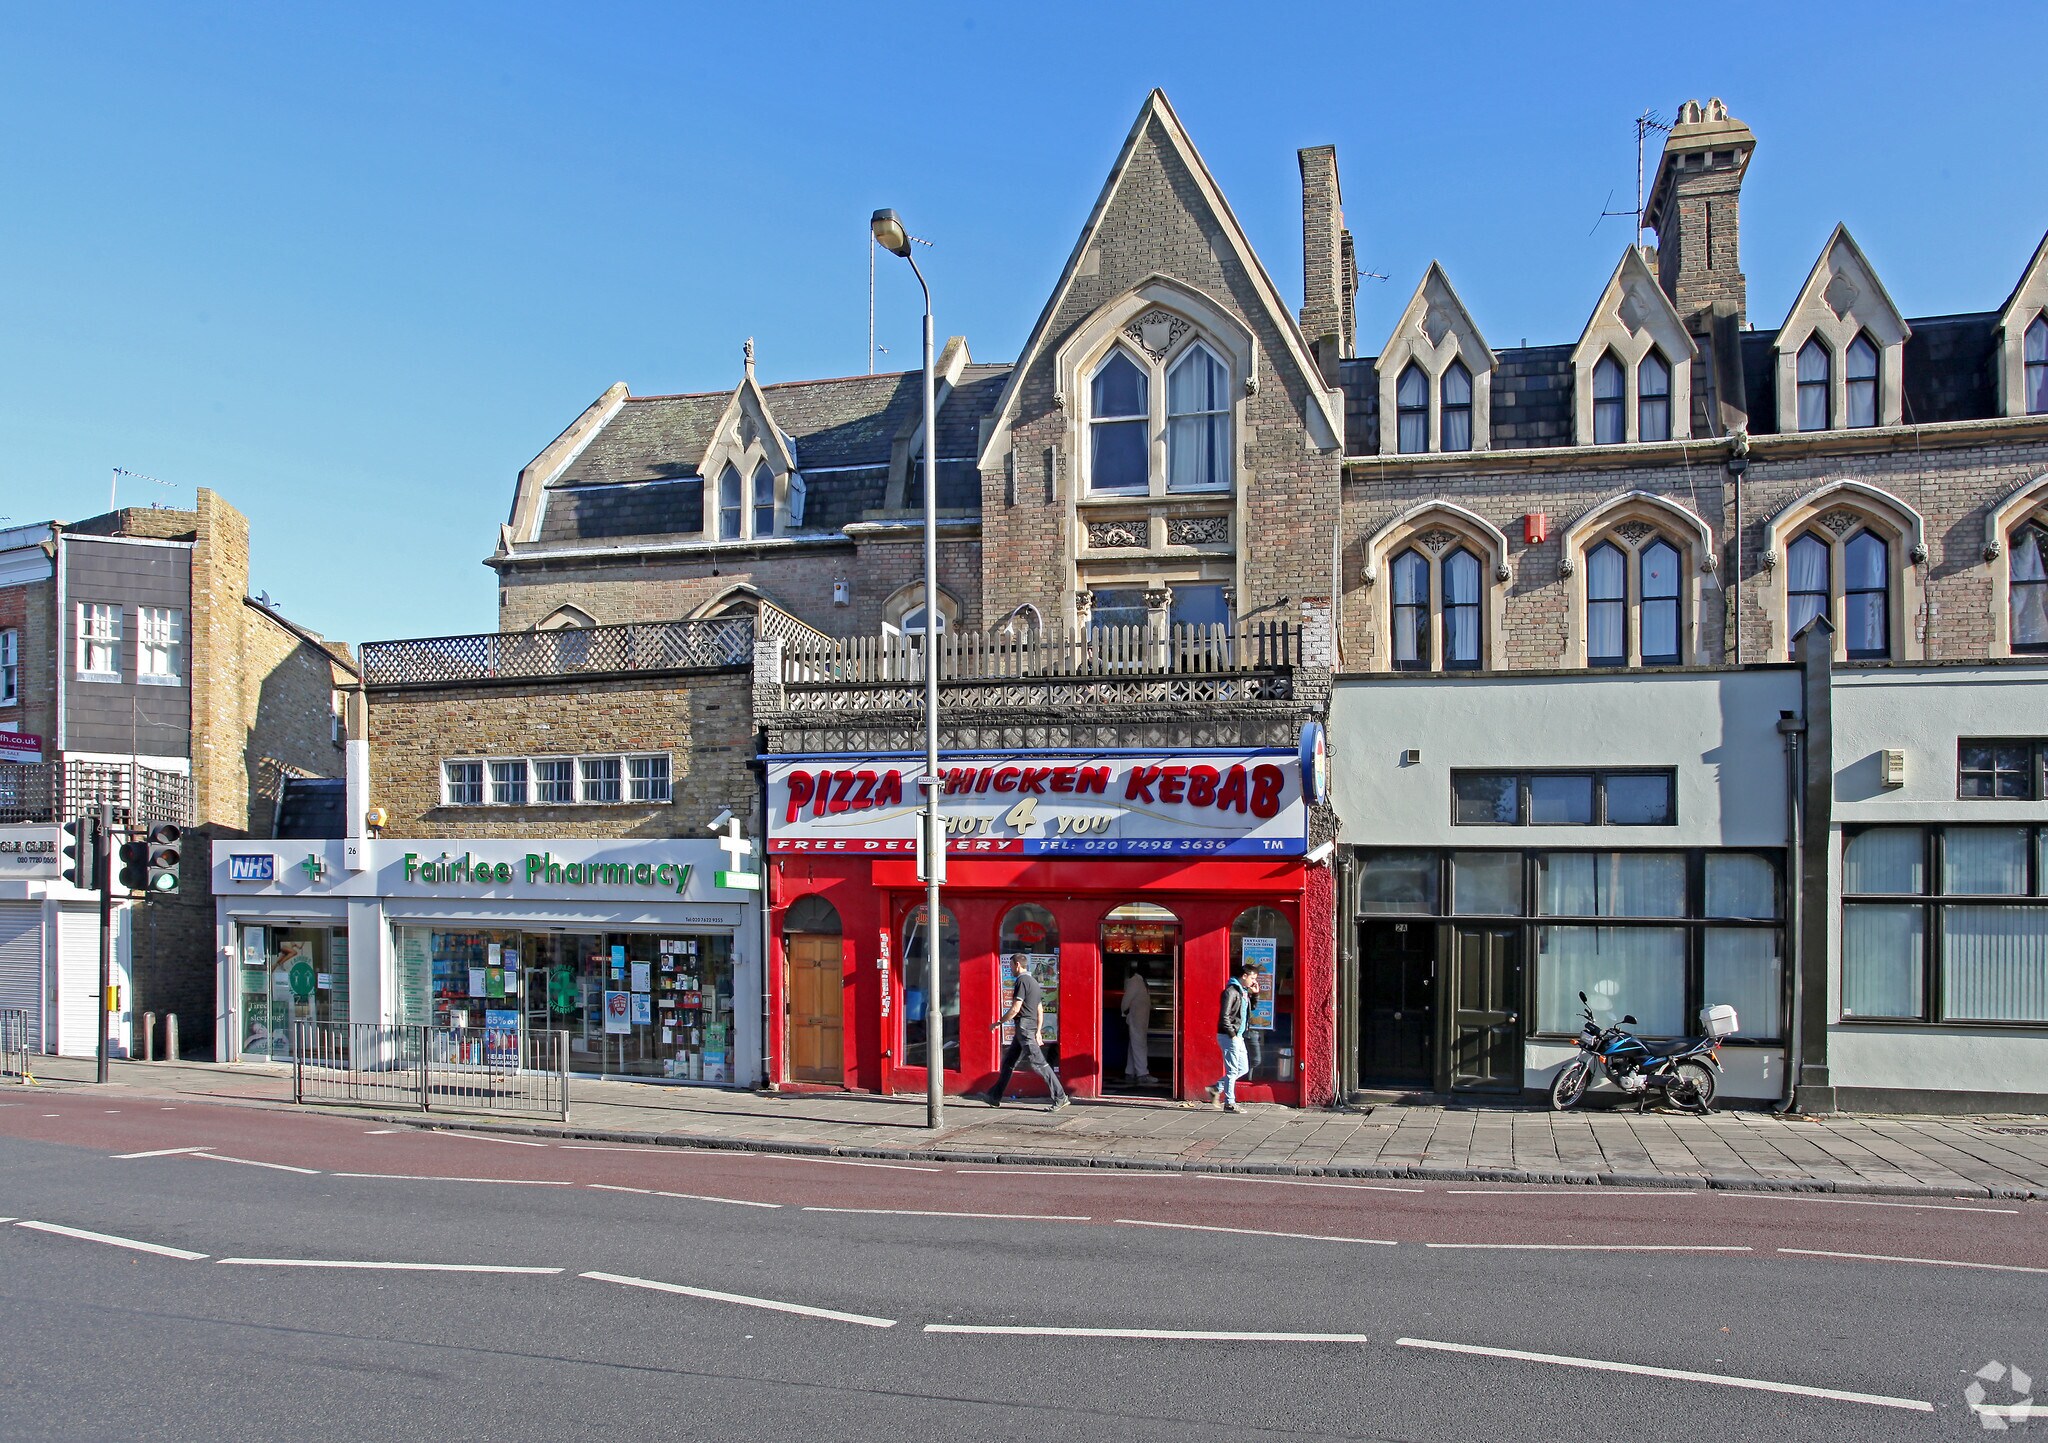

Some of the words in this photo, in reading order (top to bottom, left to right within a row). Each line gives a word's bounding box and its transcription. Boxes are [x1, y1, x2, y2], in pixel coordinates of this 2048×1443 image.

[785, 769, 903, 823] PIZZA
[1124, 763, 1285, 818] KEBAB
[1005, 797, 1038, 835] 4
[1057, 814, 1112, 834] YOU
[25, 841, 55, 852] CLUB
[777, 840, 847, 850] FREE
[864, 840, 1012, 850] DELERY
[1039, 841, 1076, 850] TEL:
[1084, 841, 1119, 850] 020
[1127, 841, 1172, 850] 7498
[1180, 841, 1227, 850] 3636
[1263, 840, 1284, 850] TM
[348, 847, 356, 855] 26
[233, 857, 273, 878] NHS
[404, 851, 513, 883] Fairlee
[525, 851, 693, 894] Pharmacy
[250, 1014, 284, 1022] sleepng?
